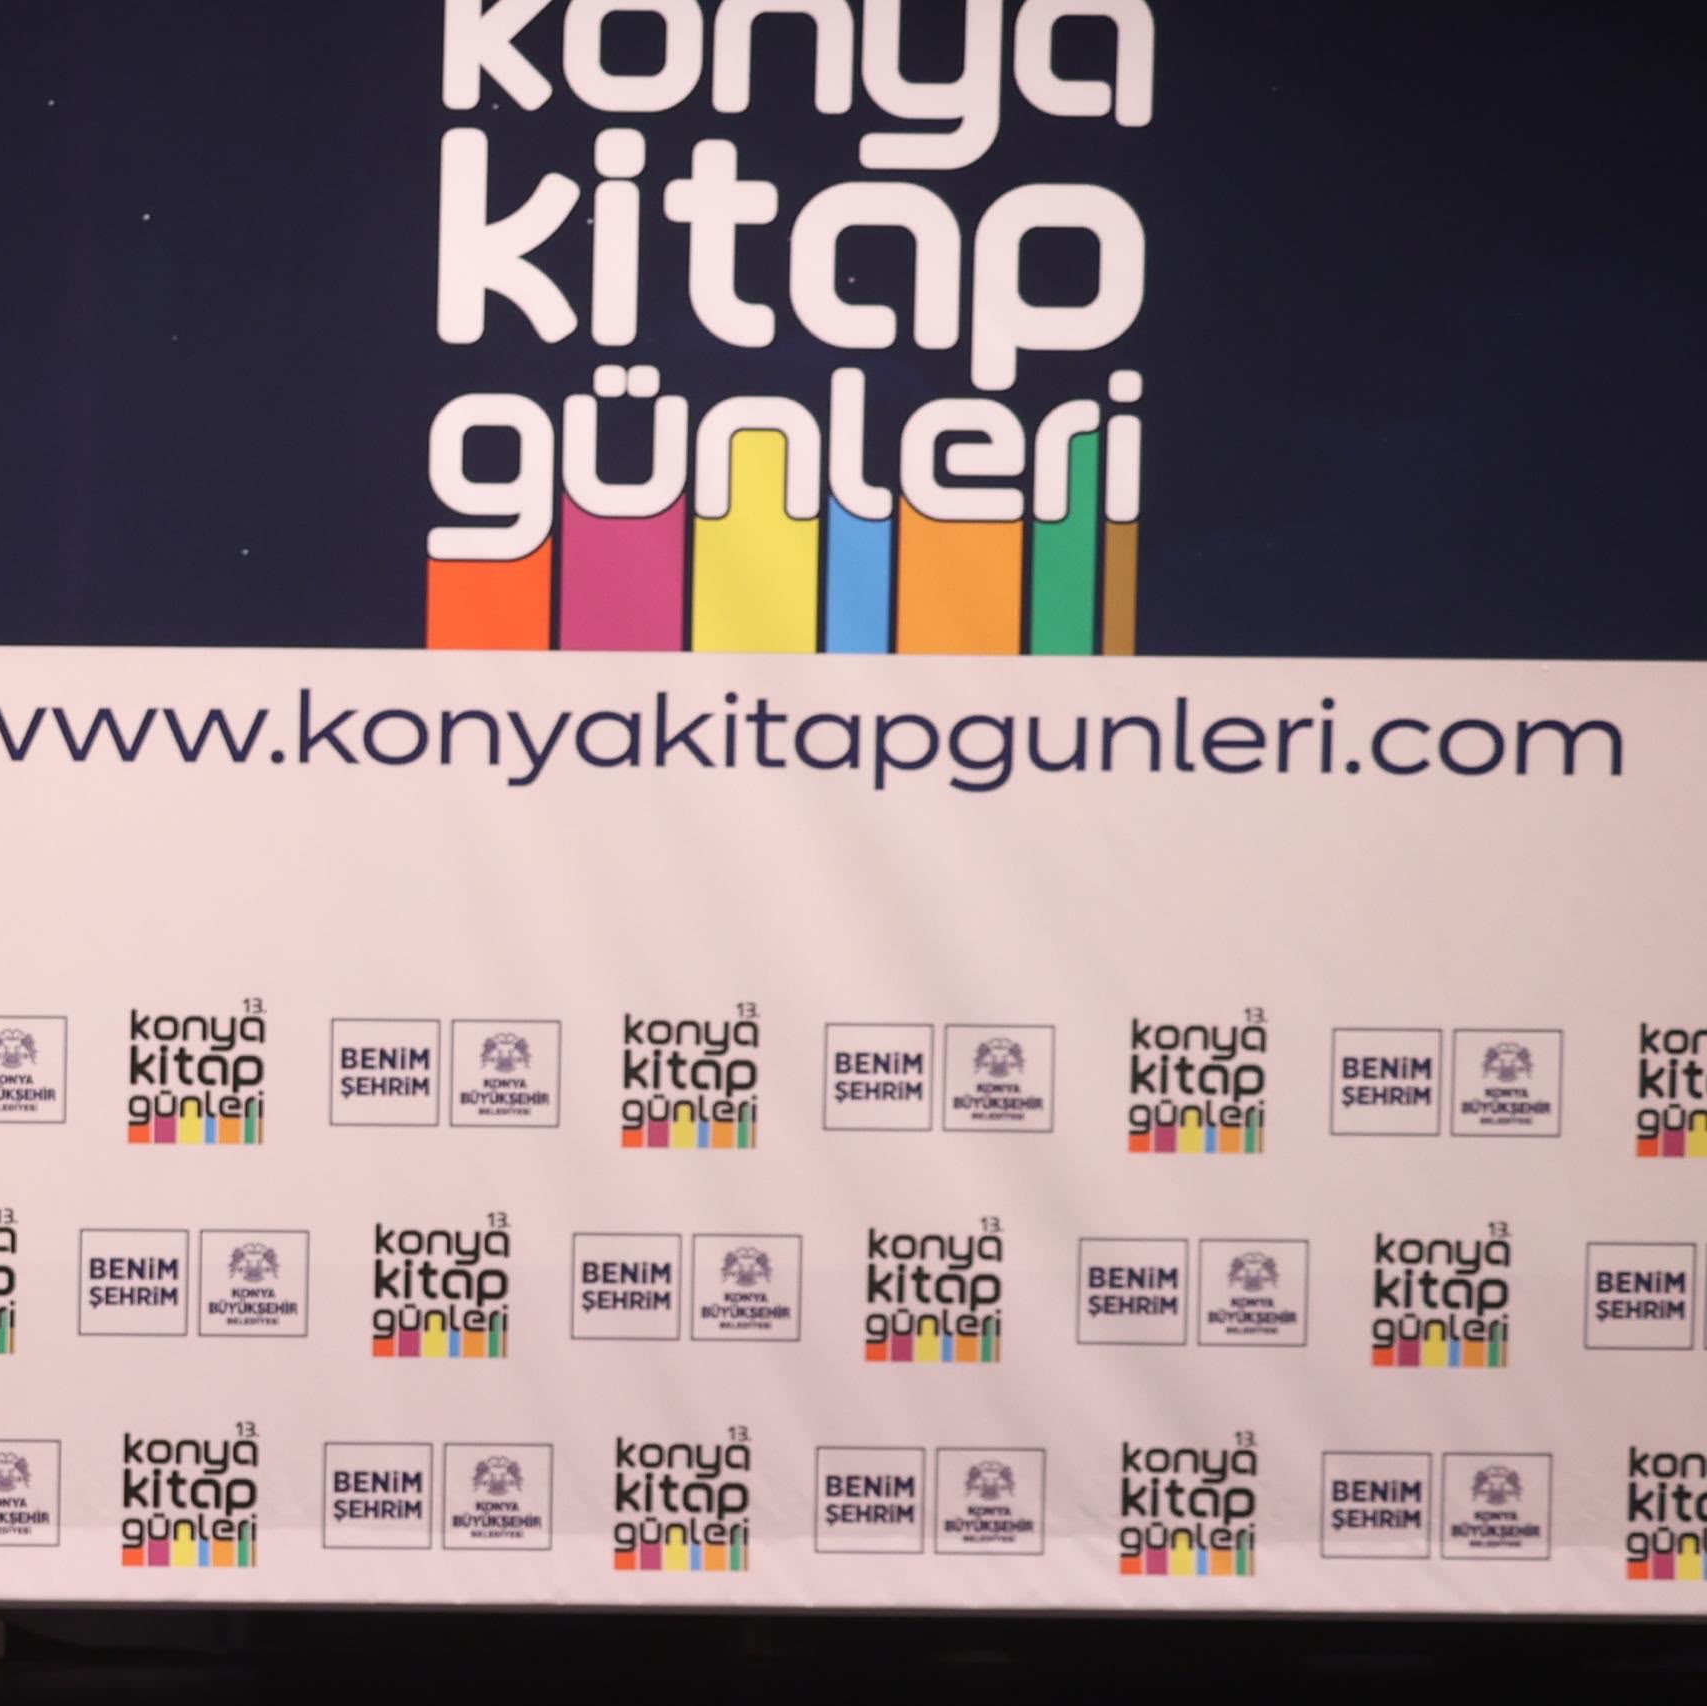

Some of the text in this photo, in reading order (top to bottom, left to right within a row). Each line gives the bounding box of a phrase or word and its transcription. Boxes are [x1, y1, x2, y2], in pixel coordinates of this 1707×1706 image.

[439, 0, 1155, 169] konya
[436, 128, 1148, 390] kitap
[426, 365, 1145, 562] günleri
[622, 1014, 759, 1056] konya
[484, 1078, 528, 1088] KONYA
[622, 1050, 759, 1097] kitap
[1485, 1087, 1529, 1098] KONYA
[621, 1094, 757, 1130] günleri
[866, 1228, 1003, 1270] konya
[725, 1292, 769, 1302] KONYA
[866, 1264, 1003, 1311] kitap
[865, 1308, 1001, 1344] günleri
[122, 1432, 257, 1474] konya
[1120, 1441, 1255, 1483] konya
[122, 1468, 257, 1515] kitap
[968, 1505, 1012, 1516] KONYA
[1120, 1477, 1255, 1524] kitap
[121, 1512, 255, 1548] günleri
[1119, 1521, 1253, 1557] günleri
